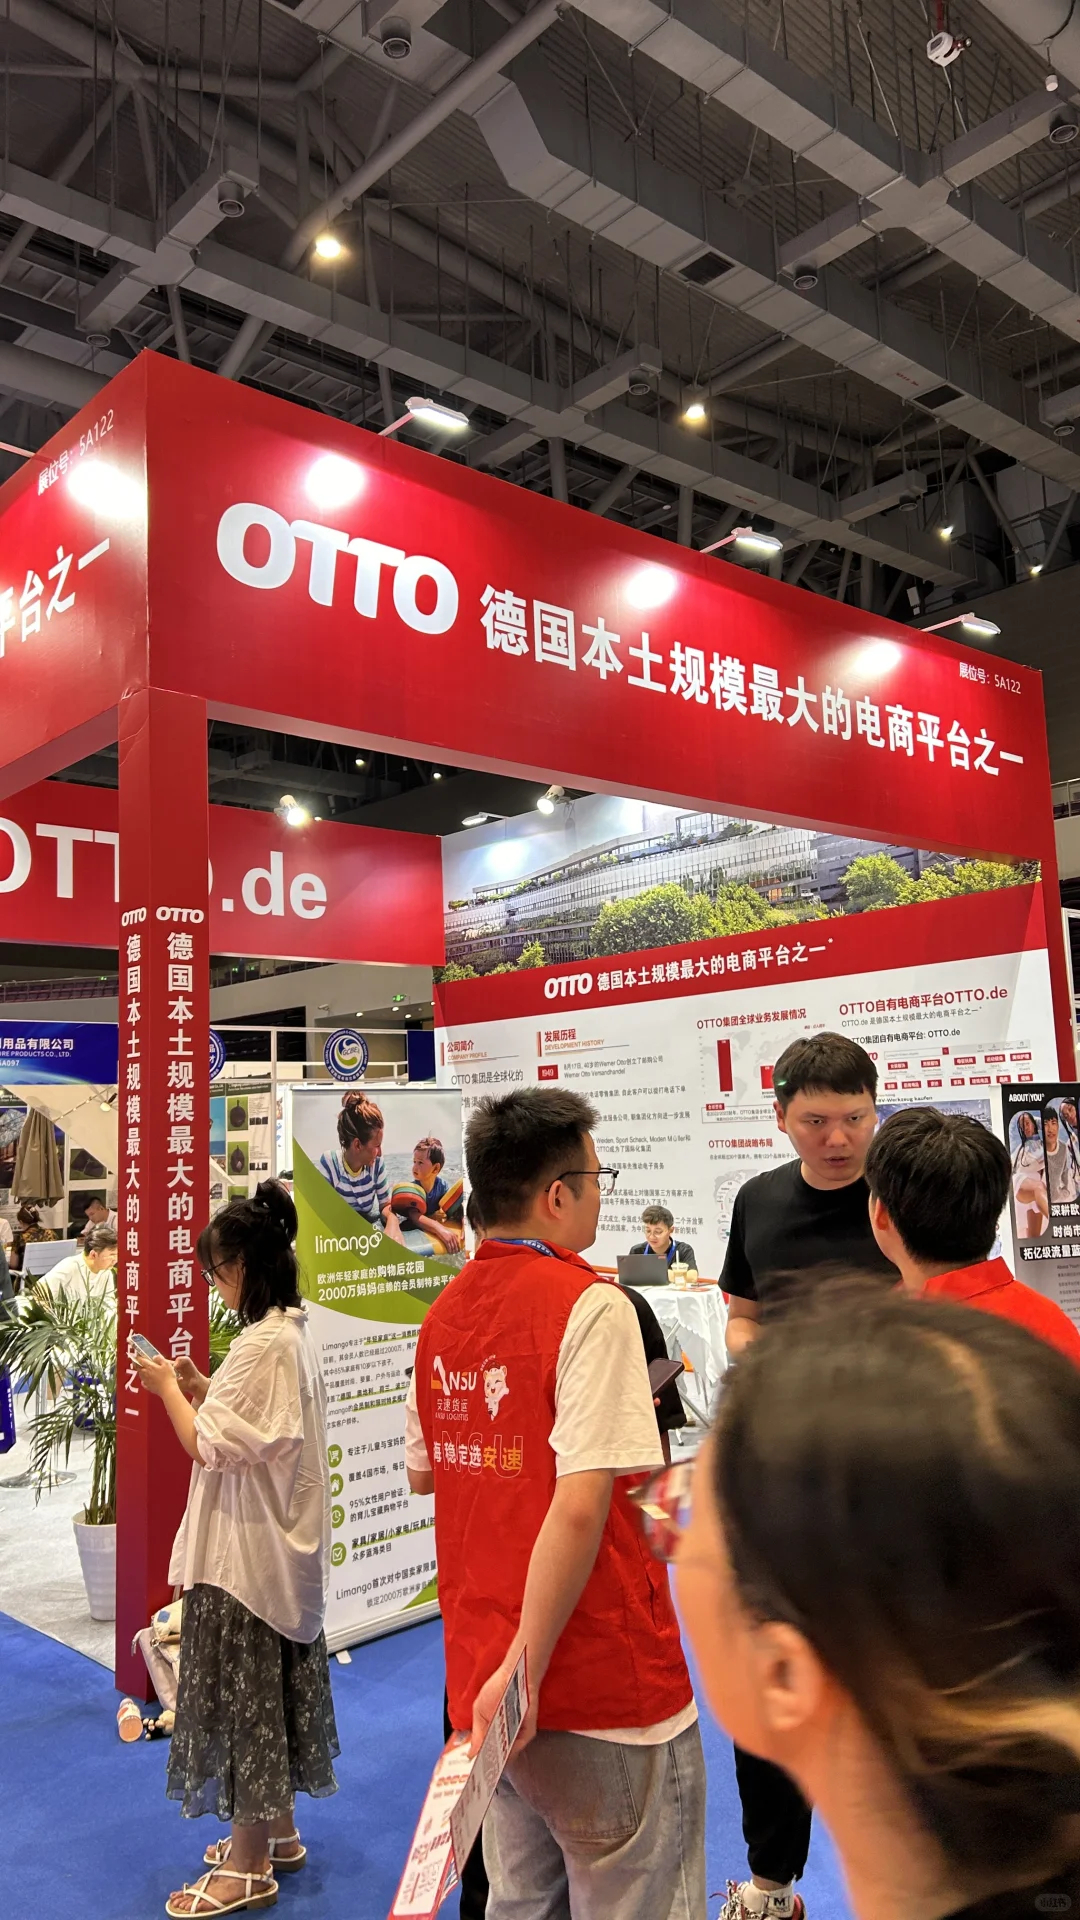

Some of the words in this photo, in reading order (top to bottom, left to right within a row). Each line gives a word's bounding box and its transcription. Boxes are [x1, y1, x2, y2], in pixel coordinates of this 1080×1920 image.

[217, 502, 459, 635] OTTO
[479, 583, 1024, 777] 德国本土规模最大的电商平台之一
[121, 907, 147, 927] OTTO
[155, 906, 205, 924] OTTO
[543, 972, 593, 999] OTTO
[839, 985, 1008, 1016] OTTO自有电商平台OTTO.de
[696, 1007, 807, 1030] OTTO集团全球业务发展情况
[0, 1037, 74, 1051] 用品有限公司
[544, 1028, 577, 1043] 发展历程
[545, 1041, 581, 1051] DEVELOPMENT
[582, 1039, 605, 1048] HISTORY
[447, 1040, 474, 1053] 公司简介
[468, 1052, 488, 1060] PROFILE
[708, 1137, 774, 1149] OTTO集团战略布局
[315, 1230, 383, 1257] limango
[317, 1260, 425, 1285] 欧洲年轻家庭的购物后花园
